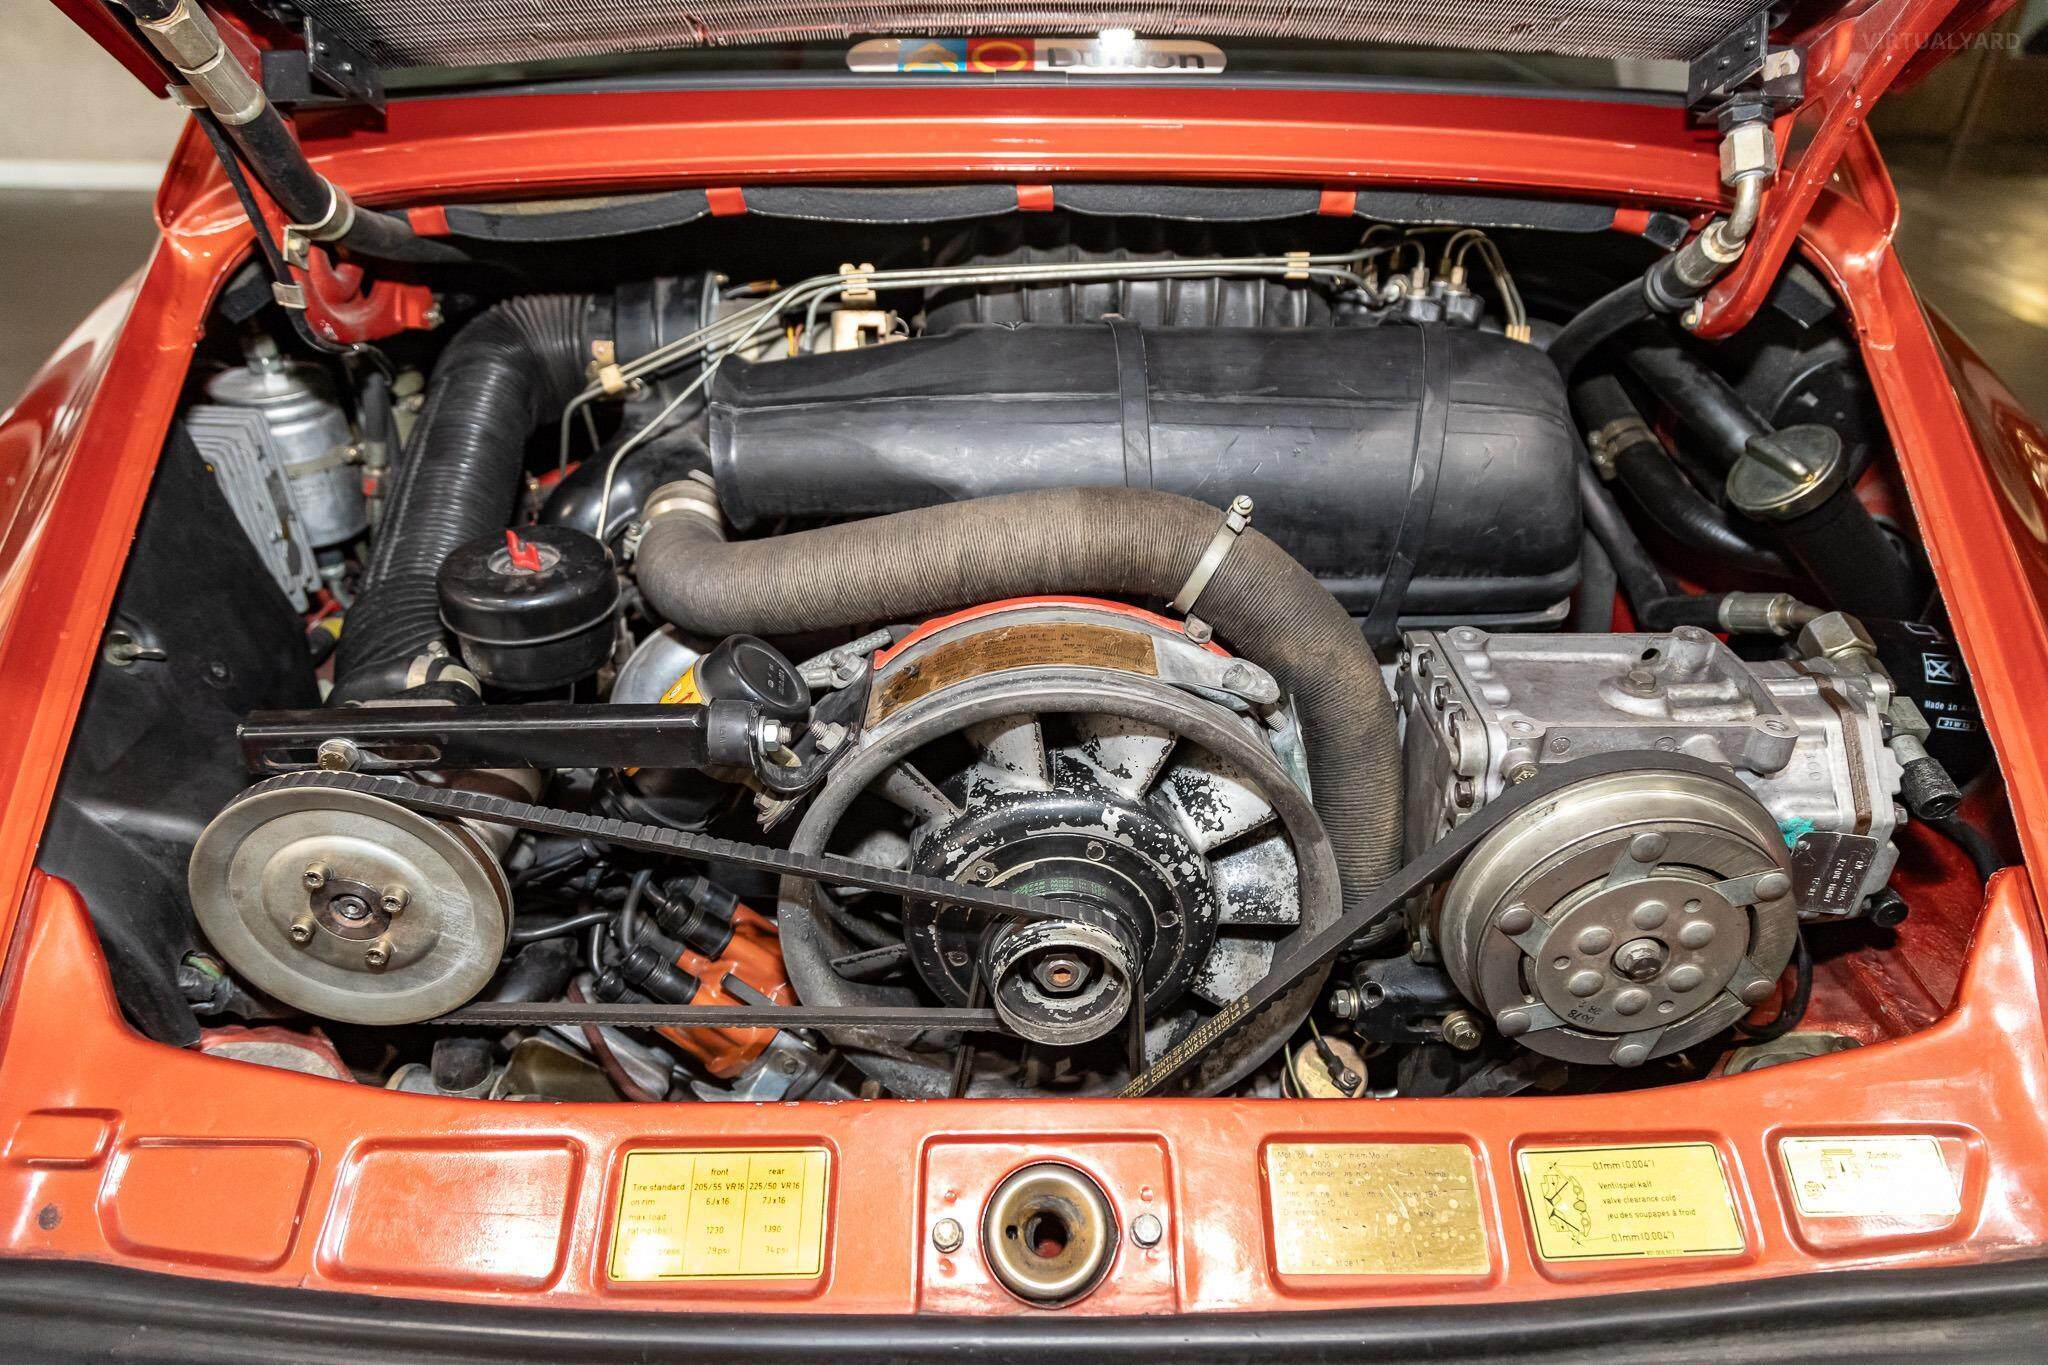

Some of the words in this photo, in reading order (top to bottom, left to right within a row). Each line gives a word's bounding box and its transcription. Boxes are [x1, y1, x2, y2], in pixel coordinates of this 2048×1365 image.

[710, 1168, 729, 1176] front
[632, 1183, 648, 1191] Tire
[649, 1183, 685, 1191] standard
[694, 1183, 722, 1191] 205/55
[749, 1182, 777, 1190] 225/50
[781, 1182, 800, 1190] VR16
[1599, 1181, 1637, 1190] Ventilspiel
[1638, 1180, 1652, 1188] kalt
[1623, 1195, 1660, 1203] clearance
[1661, 1194, 1677, 1202] cold
[1634, 1210, 1670, 1219] soupapes
[1679, 1208, 1696, 1217] froid
